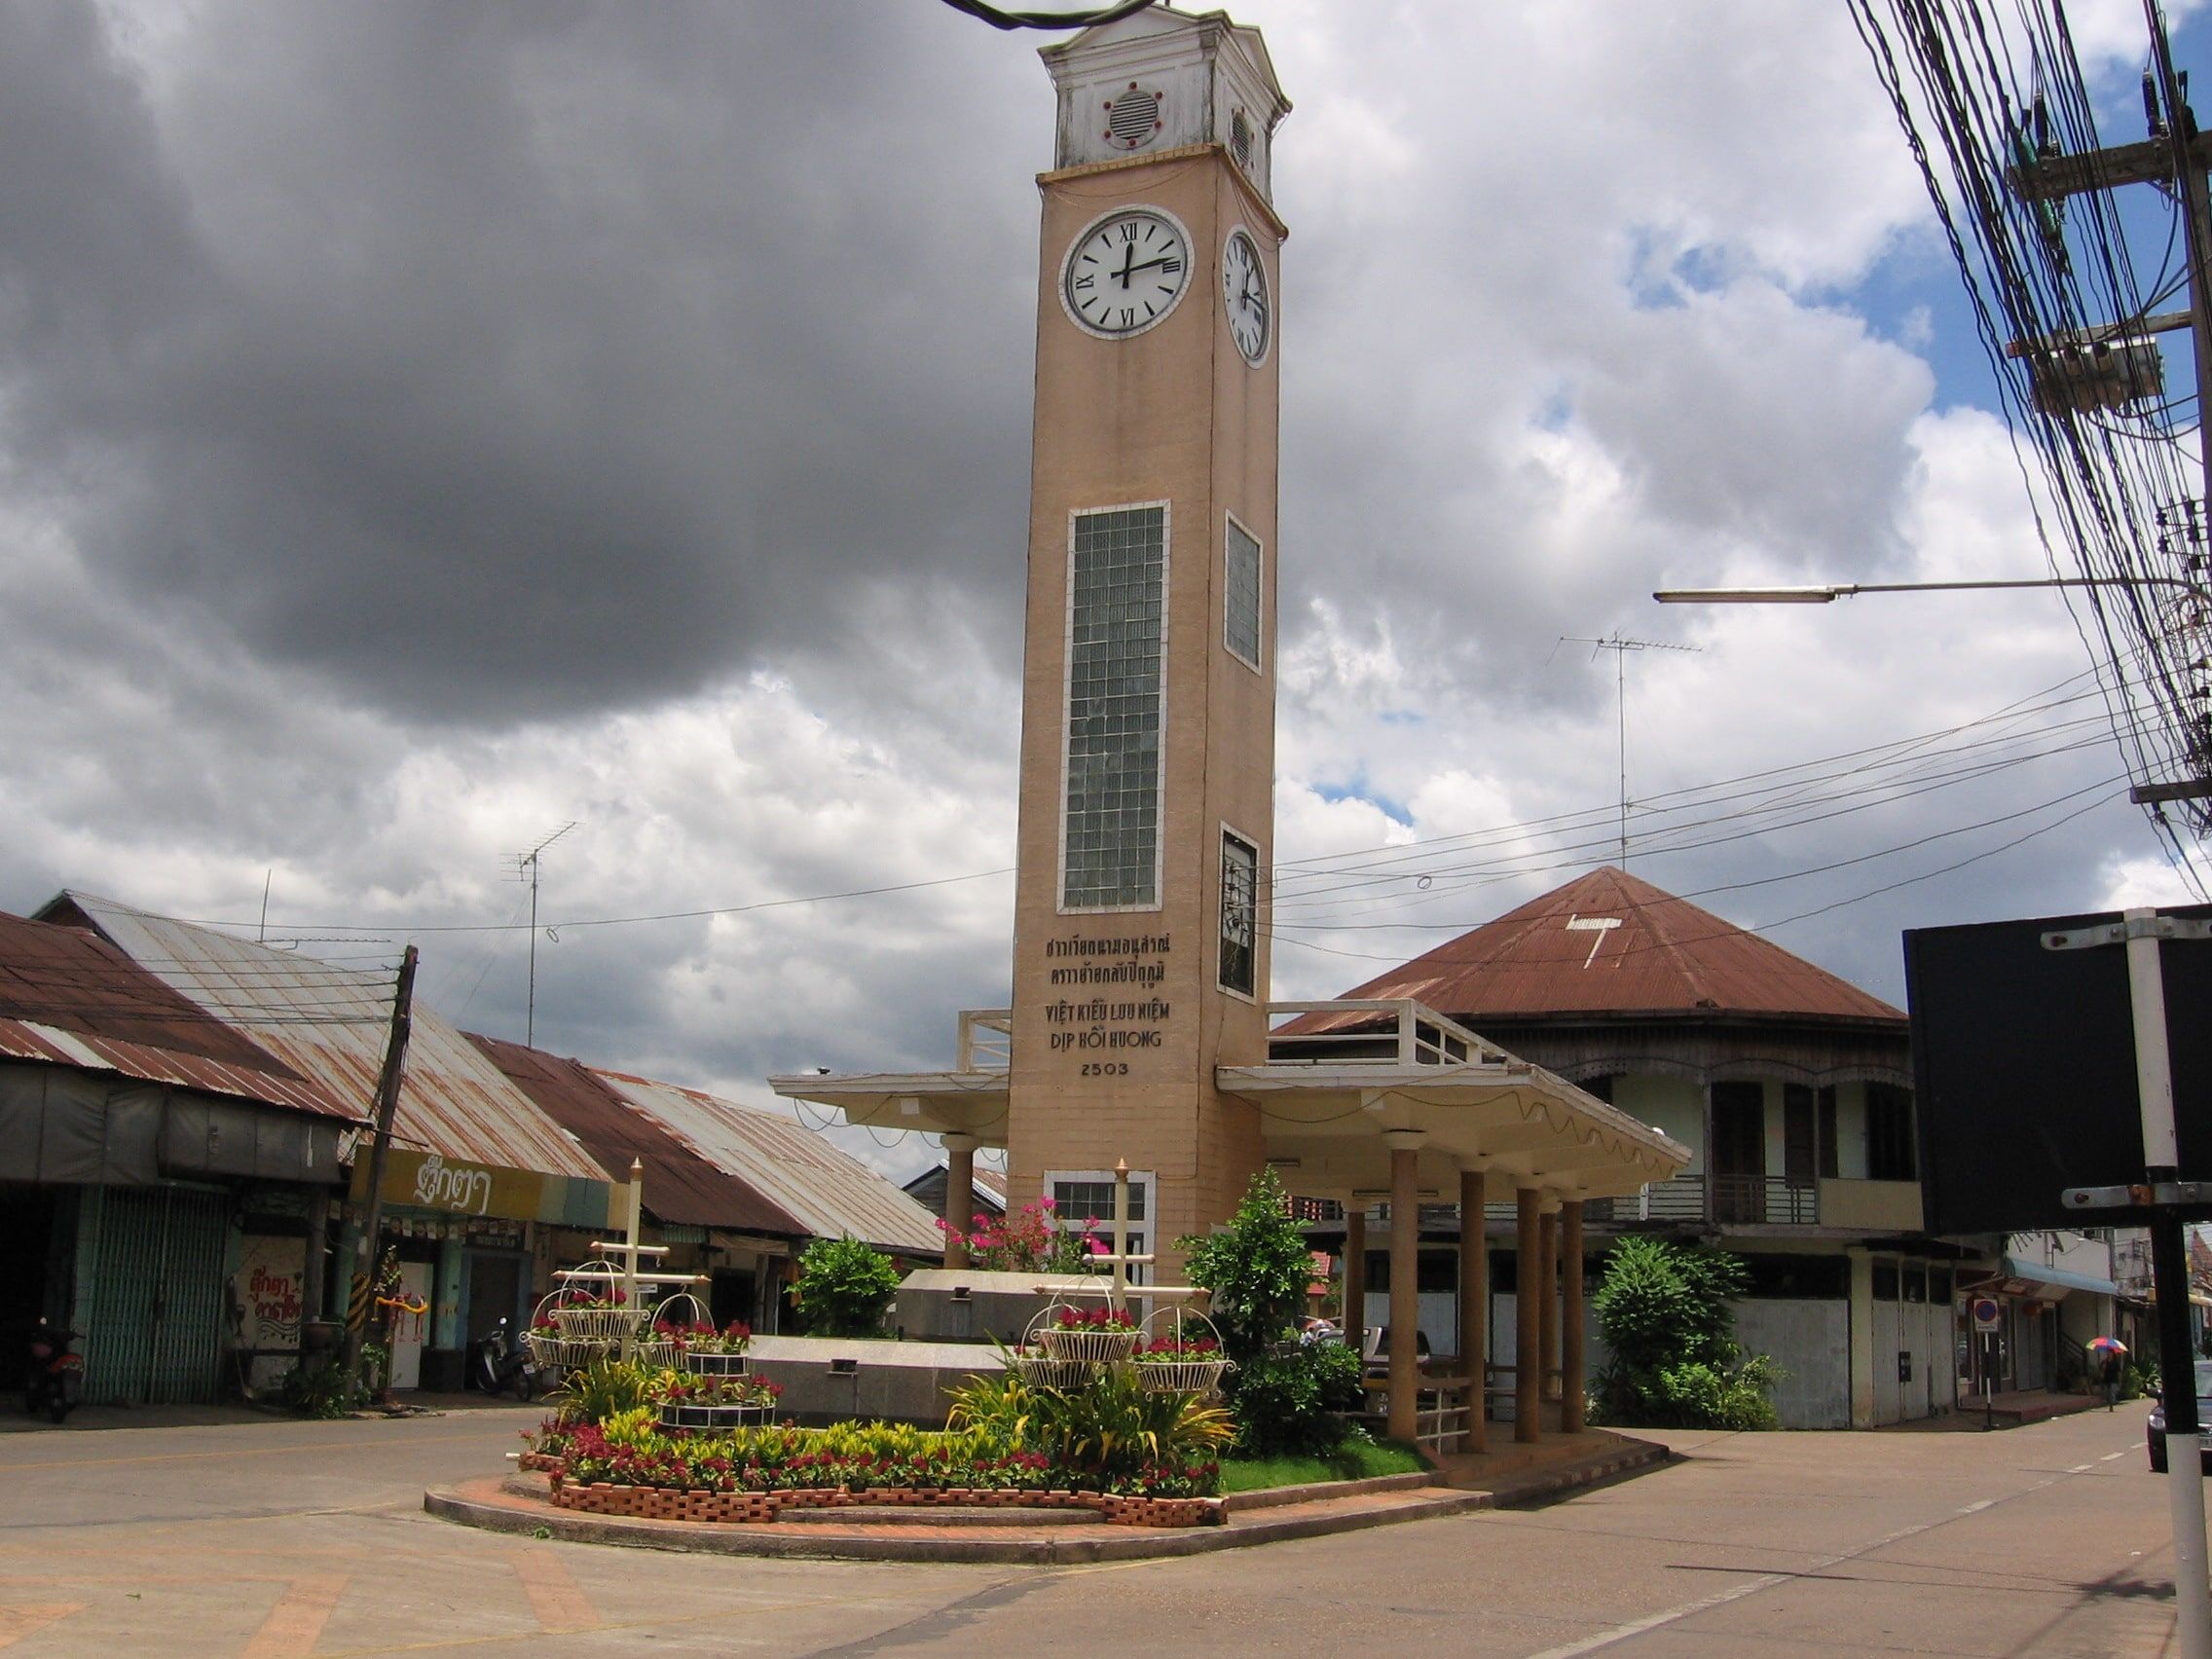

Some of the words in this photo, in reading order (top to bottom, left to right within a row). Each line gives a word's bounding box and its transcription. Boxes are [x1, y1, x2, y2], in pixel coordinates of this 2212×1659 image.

[1120, 223, 1137, 242] XII
[1161, 260, 1181, 275] III
[1076, 274, 1094, 289] IX
[1121, 308, 1134, 326] VI
[1046, 1000, 1075, 1024] VIỆT
[1137, 997, 1169, 1022] NIỆM
[1051, 1032, 1075, 1052] DỊP
[1081, 1062, 1129, 1076] 2503
[413, 1154, 493, 1216] ตุ๊กตา
